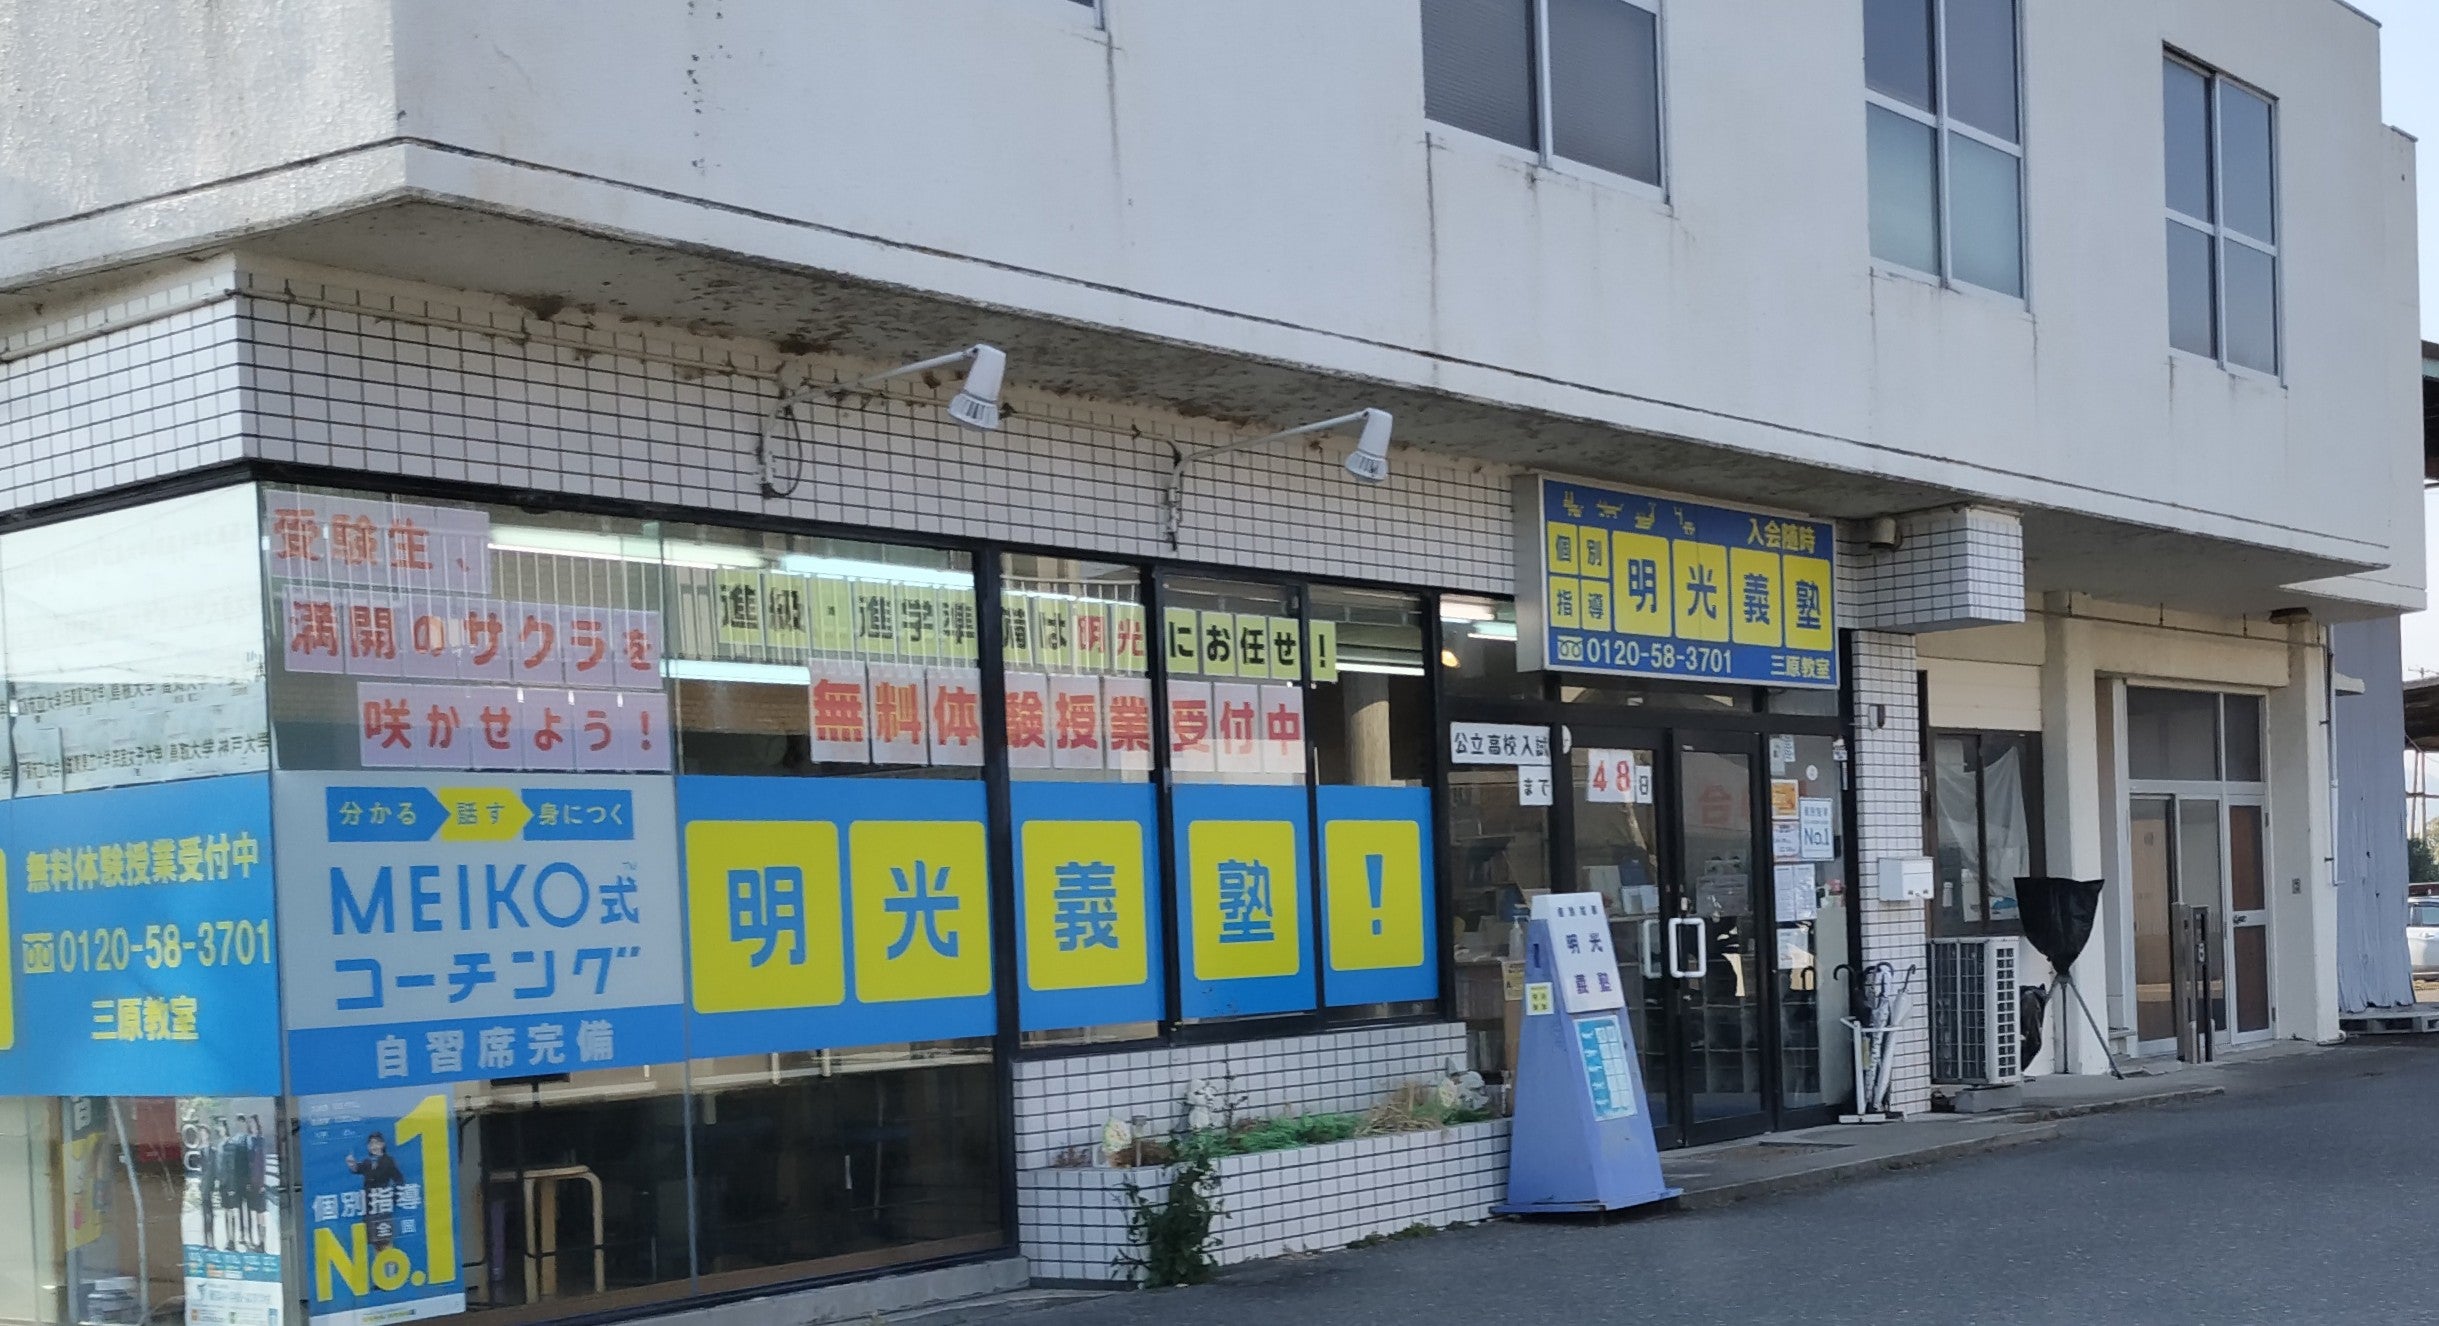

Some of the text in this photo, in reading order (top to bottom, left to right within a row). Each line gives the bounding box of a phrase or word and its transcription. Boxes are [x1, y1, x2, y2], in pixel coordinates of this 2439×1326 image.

[1556, 533, 1602, 568] 個別
[1748, 518, 1817, 556] 入会随時
[1556, 588, 1604, 621] 指導
[1628, 557, 1822, 631] 明光義塾
[290, 600, 653, 673] 満開のサクラを
[1587, 637, 1732, 675] 0120-58-3701
[1770, 654, 1831, 681] 三原教室
[812, 678, 1300, 757] 無料体験授業受付中
[339, 800, 623, 826] 分かる 話す 身につく
[26, 832, 259, 893] 無料体験授業受付中
[58, 918, 271, 974] 0120-58-3701
[334, 946, 641, 1011] コーチング
[91, 995, 199, 1042] 三原教室
[376, 1019, 615, 1079] 自習席完備
[312, 1183, 422, 1223] 個別指導
[314, 1094, 456, 1303] No.1
